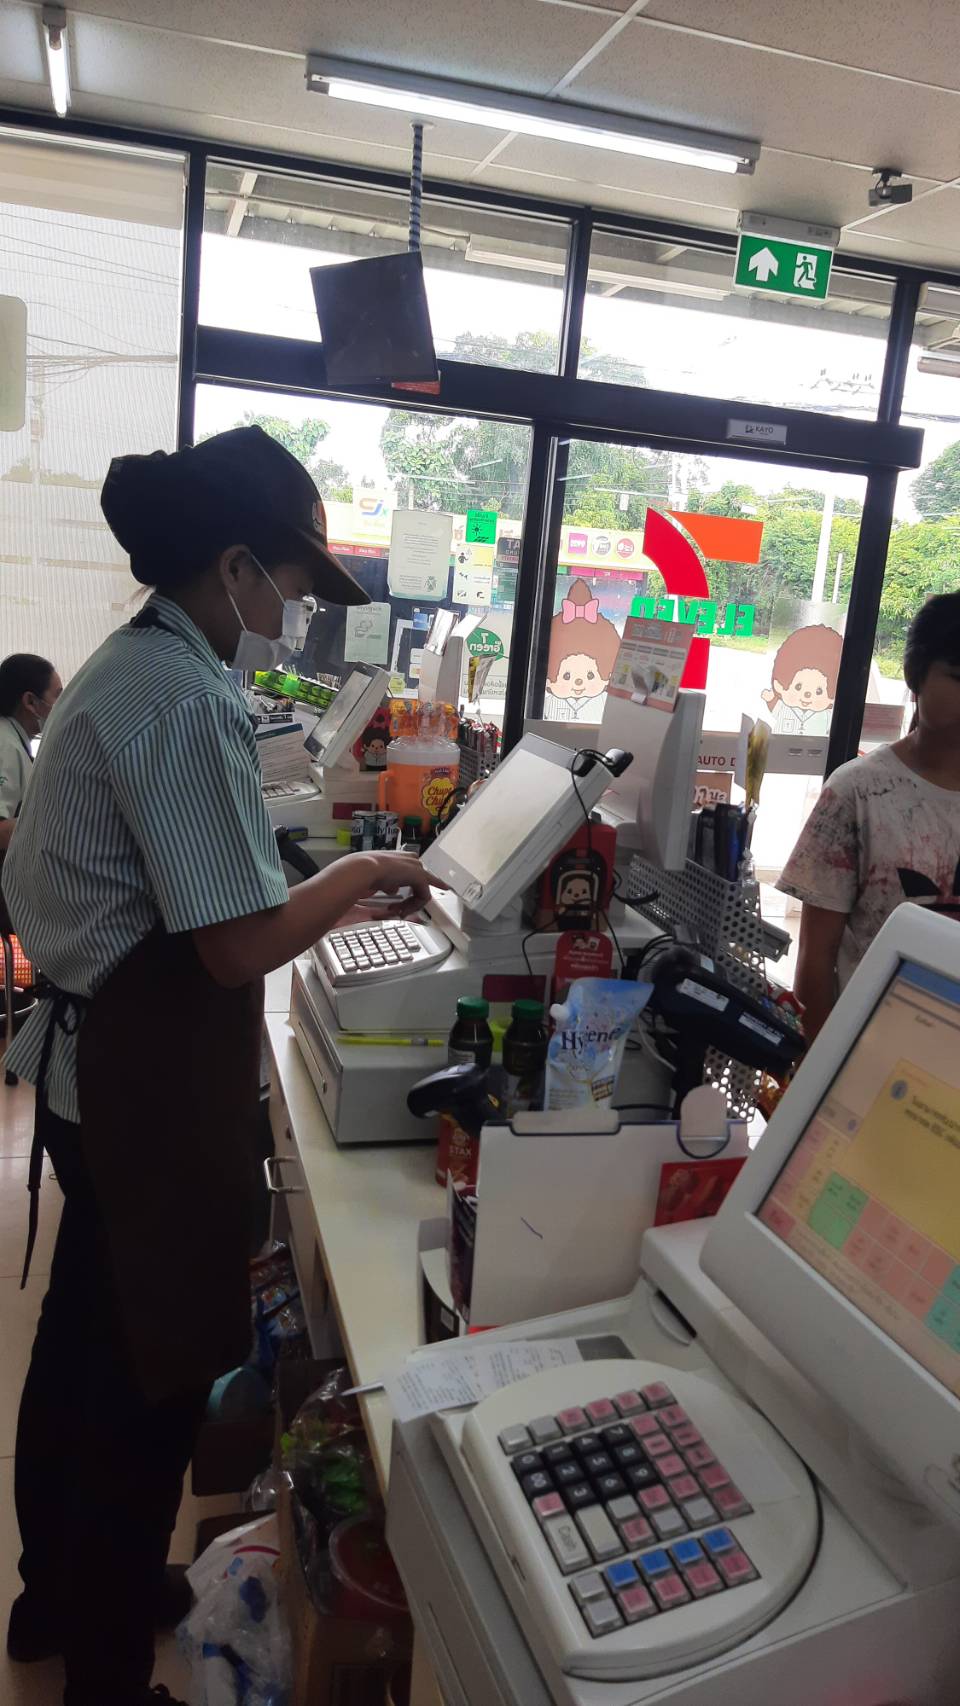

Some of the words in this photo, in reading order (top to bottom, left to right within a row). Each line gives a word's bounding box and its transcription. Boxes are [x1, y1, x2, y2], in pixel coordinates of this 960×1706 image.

[755, 425, 774, 434] KAYO
[697, 754, 726, 766] AUTO
[592, 1456, 607, 1466] 5
[561, 1465, 576, 1475] 2
[573, 1486, 588, 1497] 3
